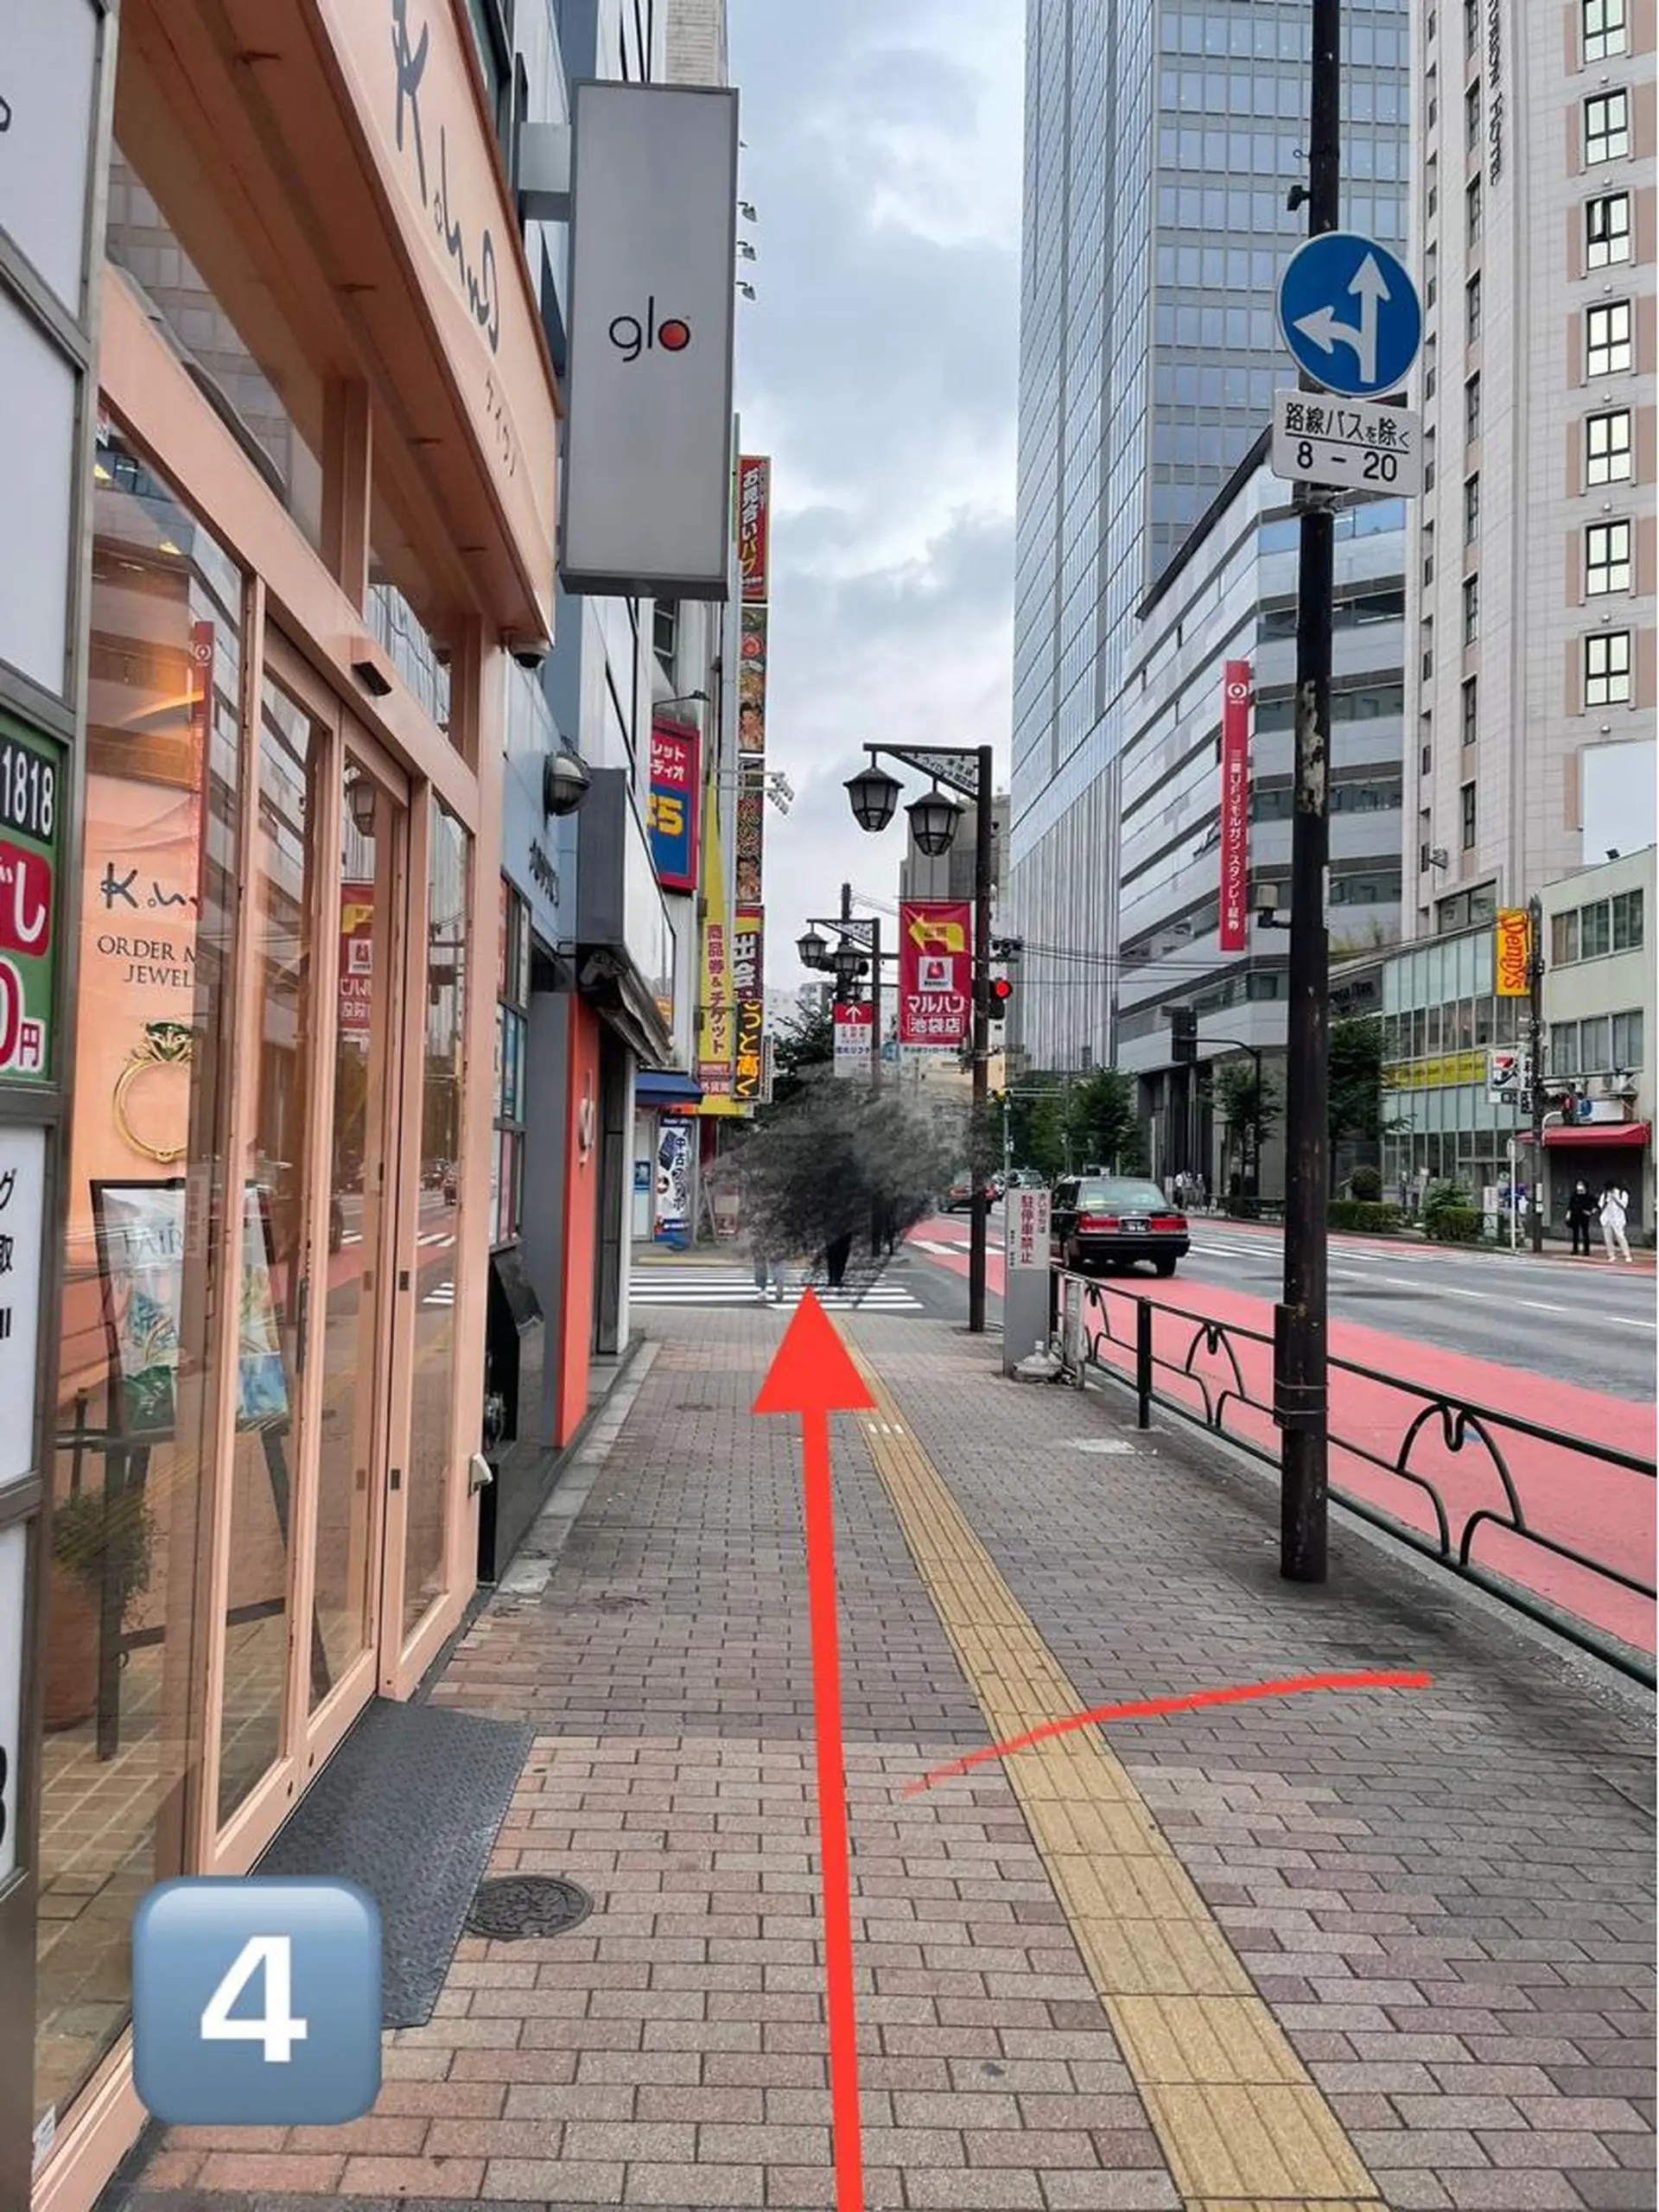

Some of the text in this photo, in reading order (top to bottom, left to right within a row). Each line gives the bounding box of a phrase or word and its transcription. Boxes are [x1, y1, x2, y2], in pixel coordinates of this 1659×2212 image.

[609, 296, 690, 362] glo
[1285, 402, 1411, 448] 路線バスを除く
[1297, 441, 1313, 469] 8
[1363, 451, 1397, 482] 20
[97, 934, 175, 961] ORDER
[908, 995, 965, 1014] マルハン
[911, 1017, 961, 1033] 池袋店
[1021, 1194, 1033, 1264] 駐停車禁止
